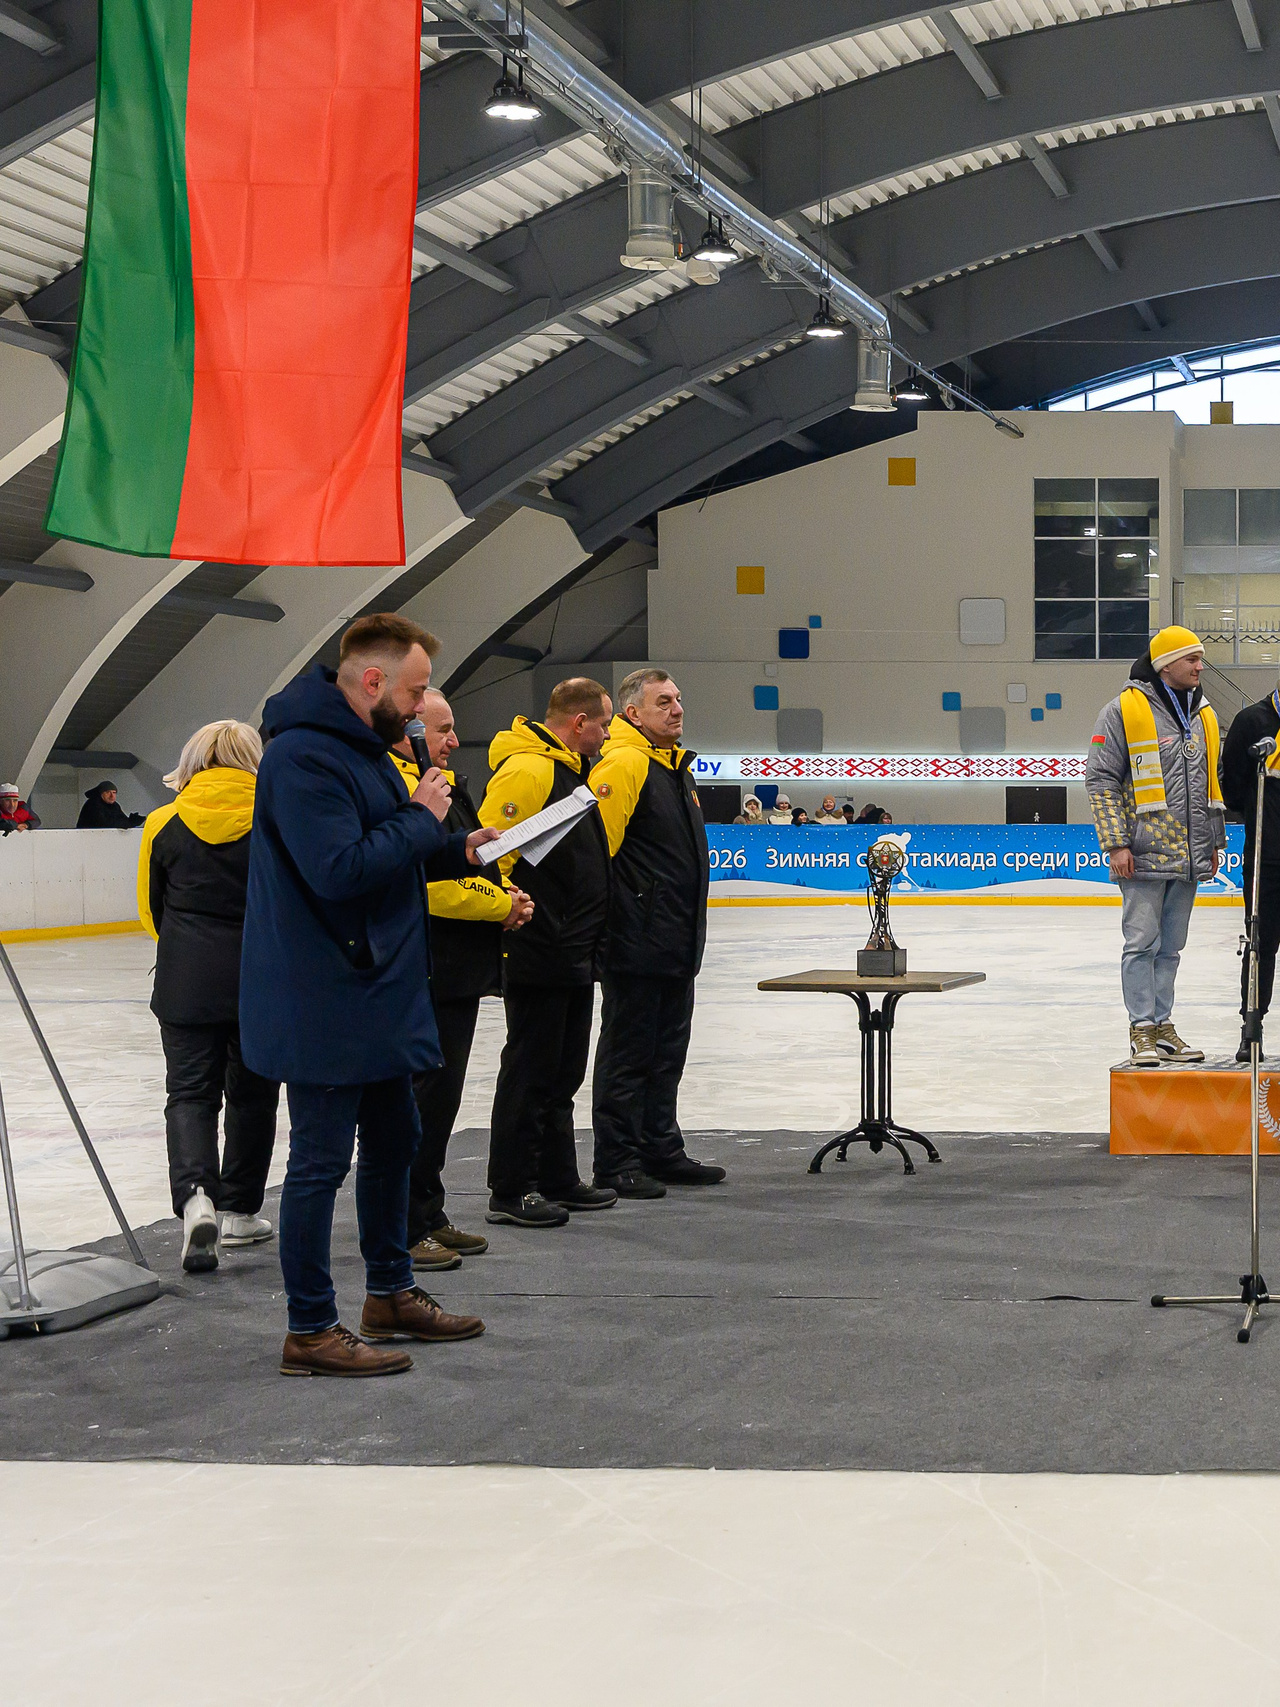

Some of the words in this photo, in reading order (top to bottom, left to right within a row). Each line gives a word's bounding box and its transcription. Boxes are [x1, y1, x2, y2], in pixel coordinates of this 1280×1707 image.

[709, 848, 747, 869] 026
[765, 848, 850, 869] Зимняя
[856, 851, 997, 871] стакиада
[1003, 851, 1069, 872] среди
[456, 878, 496, 898] ELARUS
